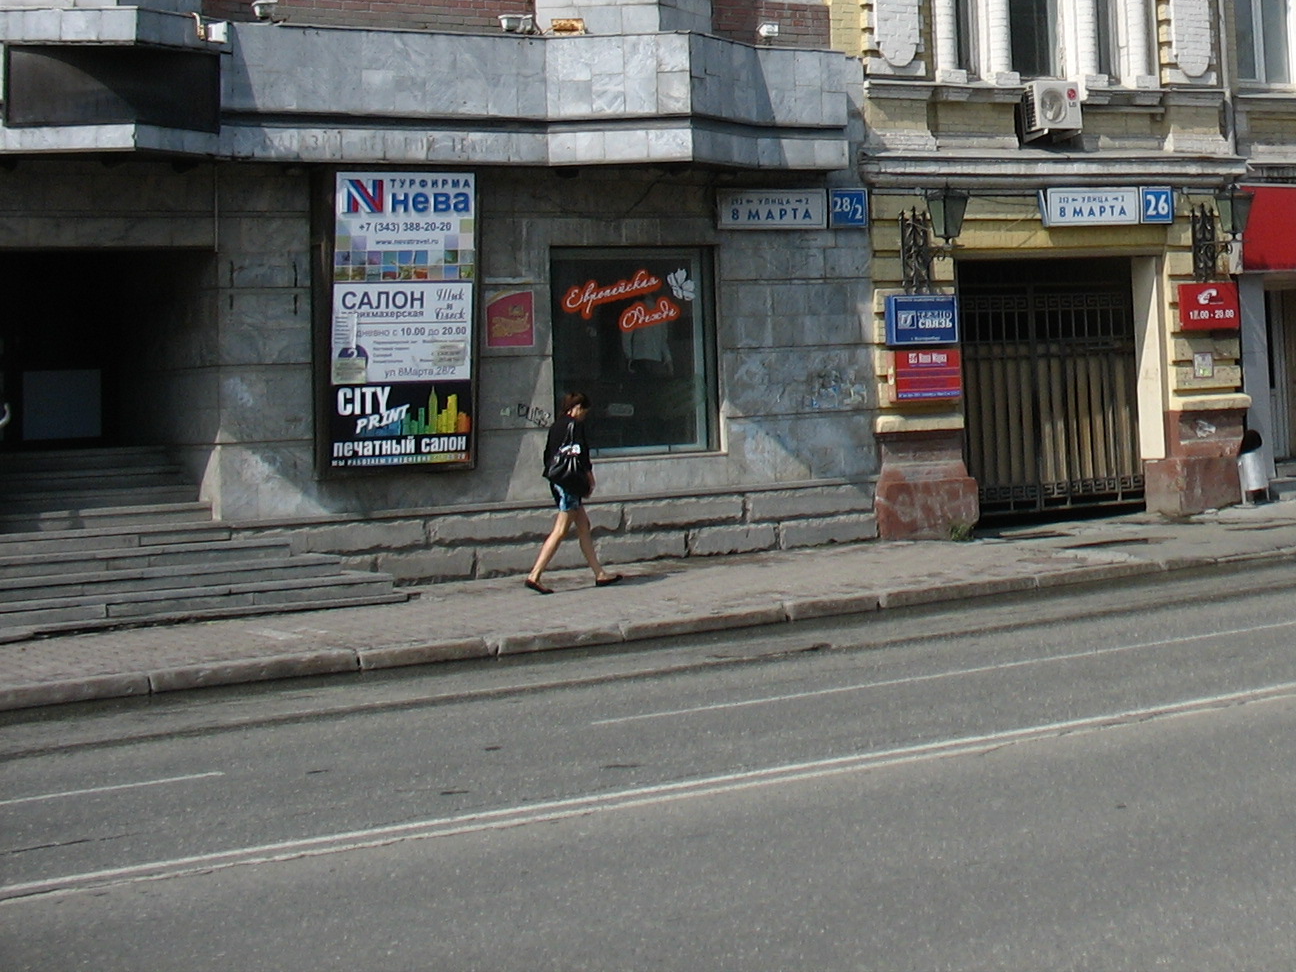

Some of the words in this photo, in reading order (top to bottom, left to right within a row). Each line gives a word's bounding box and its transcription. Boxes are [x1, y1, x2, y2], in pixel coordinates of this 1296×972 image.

[390, 179, 471, 188] ТУРФИРМА
[390, 192, 471, 213] нева
[758, 198, 790, 206] УЛИЦА
[1081, 196, 1109, 204] УЛИЦА
[1146, 194, 1169, 216] 26
[731, 209, 739, 221] 8
[747, 208, 812, 221] МАРТА
[833, 196, 863, 220] 28/2
[1059, 206, 1066, 218] 8
[1072, 205, 1127, 218] МАРТА
[359, 222, 371, 232] +7
[374, 222, 400, 233] (343)
[403, 221, 452, 232] 388-20-20
[341, 291, 425, 310] САЛОН
[918, 319, 953, 329] СВЯЗЬ
[401, 327, 426, 336] 10.00
[442, 326, 467, 335] 20.00
[337, 386, 391, 416] CITY
[355, 404, 411, 435] PRINT
[333, 436, 416, 458] печатный
[421, 436, 467, 453] салон
